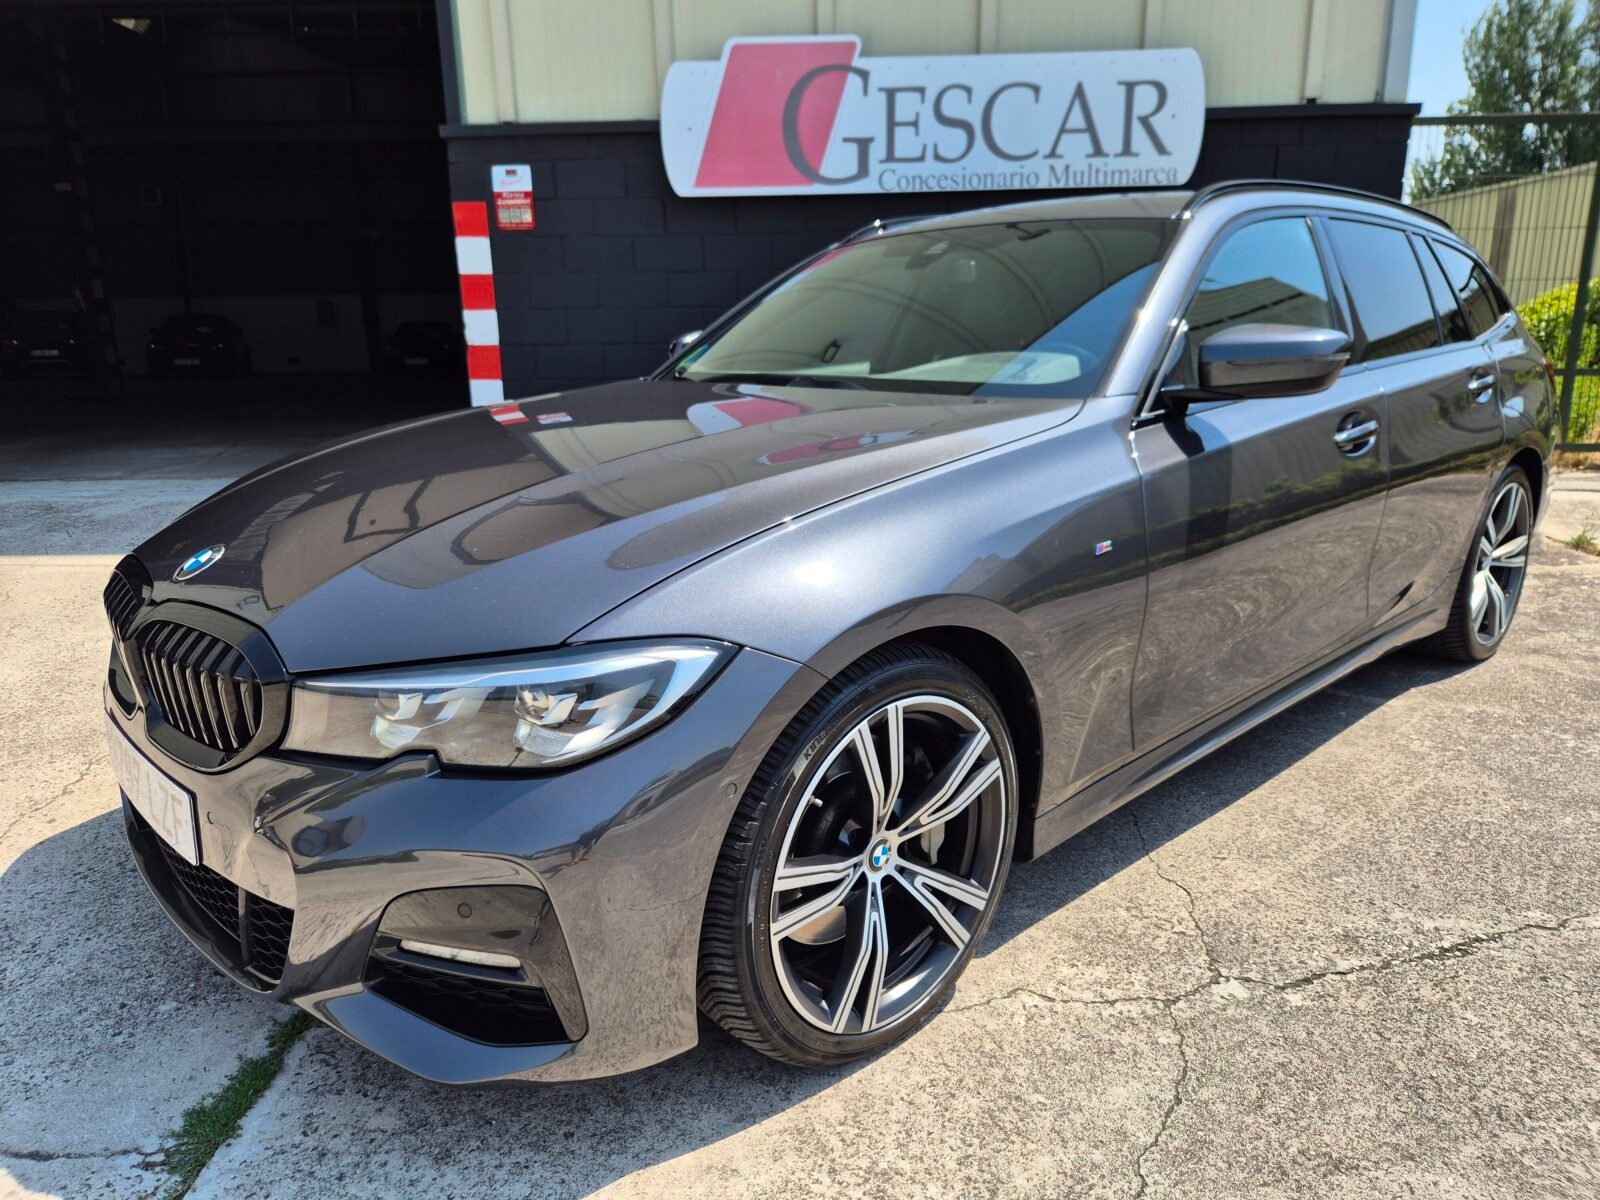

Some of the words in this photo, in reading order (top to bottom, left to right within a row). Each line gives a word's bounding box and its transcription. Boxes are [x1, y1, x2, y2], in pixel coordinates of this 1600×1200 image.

[782, 64, 1172, 185] GESCAR
[878, 166, 1039, 192] Concesionario
[1047, 163, 1178, 186] Multimarca
